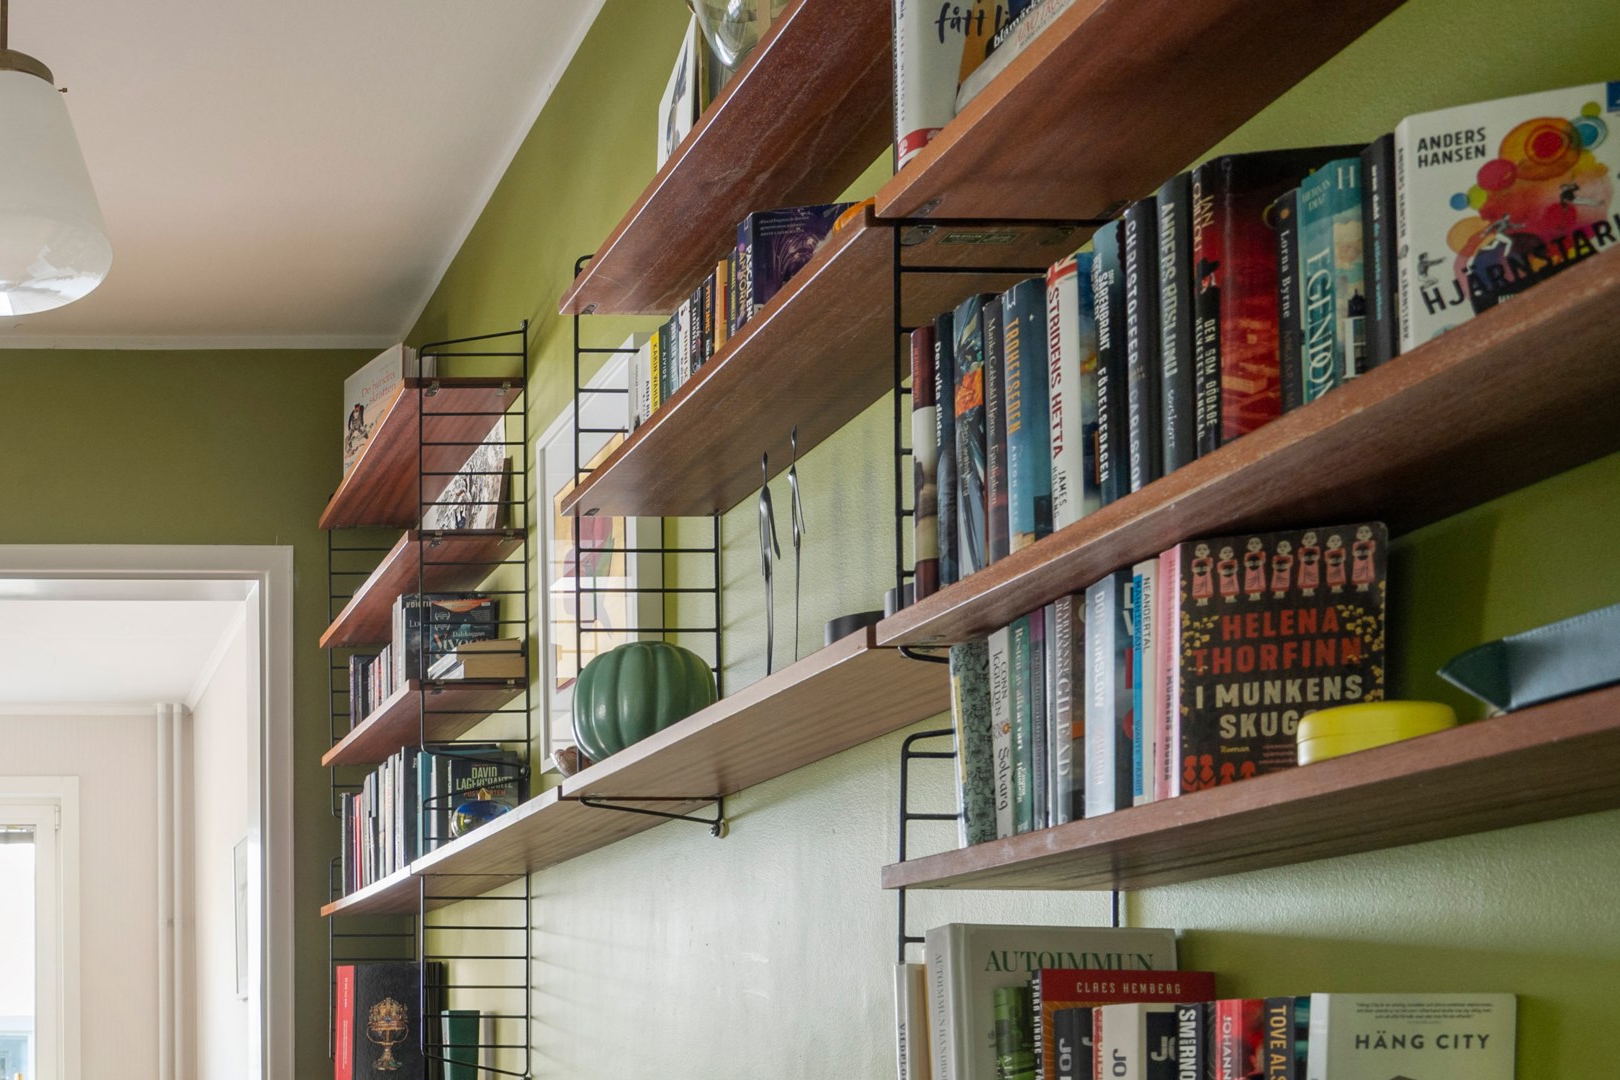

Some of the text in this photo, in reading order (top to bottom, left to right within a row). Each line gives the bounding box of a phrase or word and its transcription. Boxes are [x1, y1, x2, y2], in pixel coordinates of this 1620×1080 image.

[934, 2, 986, 44] fått
[1417, 127, 1486, 152] ANDERS
[1418, 144, 1486, 168] HANSEN
[1193, 182, 1203, 252] GUILLOU
[1201, 195, 1215, 228] JAN
[1399, 194, 1407, 239] HANSEN
[1280, 229, 1291, 319] Lorna Byrne
[1419, 212, 1620, 316] HJÄRNSTAR
[1098, 272, 1111, 351] SARENBRANT
[1125, 219, 1138, 367] CHRISTOFFER
[1160, 202, 1178, 379] ANDERS ROSLUND
[987, 317, 996, 355] Marika
[1196, 317, 1205, 385] HELVETETS
[988, 356, 997, 399] Cobbold
[1005, 317, 1021, 436] TROHETSEDEN
[1048, 286, 1064, 459] STRIDENS HETTA
[1204, 318, 1217, 427] DEN SOM DÖDADE
[934, 341, 943, 447] Den vita döden
[989, 400, 997, 437] Hjörne
[1097, 366, 1109, 483] FÖDELSEDAGEN
[1058, 470, 1068, 506] JAMES
[1143, 576, 1152, 652] NEANDERTAL
[1222, 607, 1340, 641] HELENA
[1094, 590, 1106, 708] DON WINSLOW
[1191, 637, 1362, 677] THORFINN
[1195, 675, 1363, 709] I MUNKENS
[993, 650, 1010, 811] IGGULDEN Solvarg
[1057, 676, 1072, 776] GILEAD
[1219, 709, 1302, 739] SKUG
[1220, 745, 1250, 753] Roman
[471, 767, 498, 778] DAVID
[984, 950, 1154, 972] AUTOIMMUN
[935, 953, 946, 1026] AUTOIMMUN
[1032, 979, 1040, 1011] SPARA
[1076, 982, 1181, 995] CLAES HEMBERG
[1033, 1015, 1042, 1054] MINDRE
[1269, 1005, 1287, 1049] TOVE
[1355, 1030, 1490, 1050] HÄNG CITY
[1059, 1038, 1072, 1071] JO
[1112, 1048, 1127, 1077] JO
